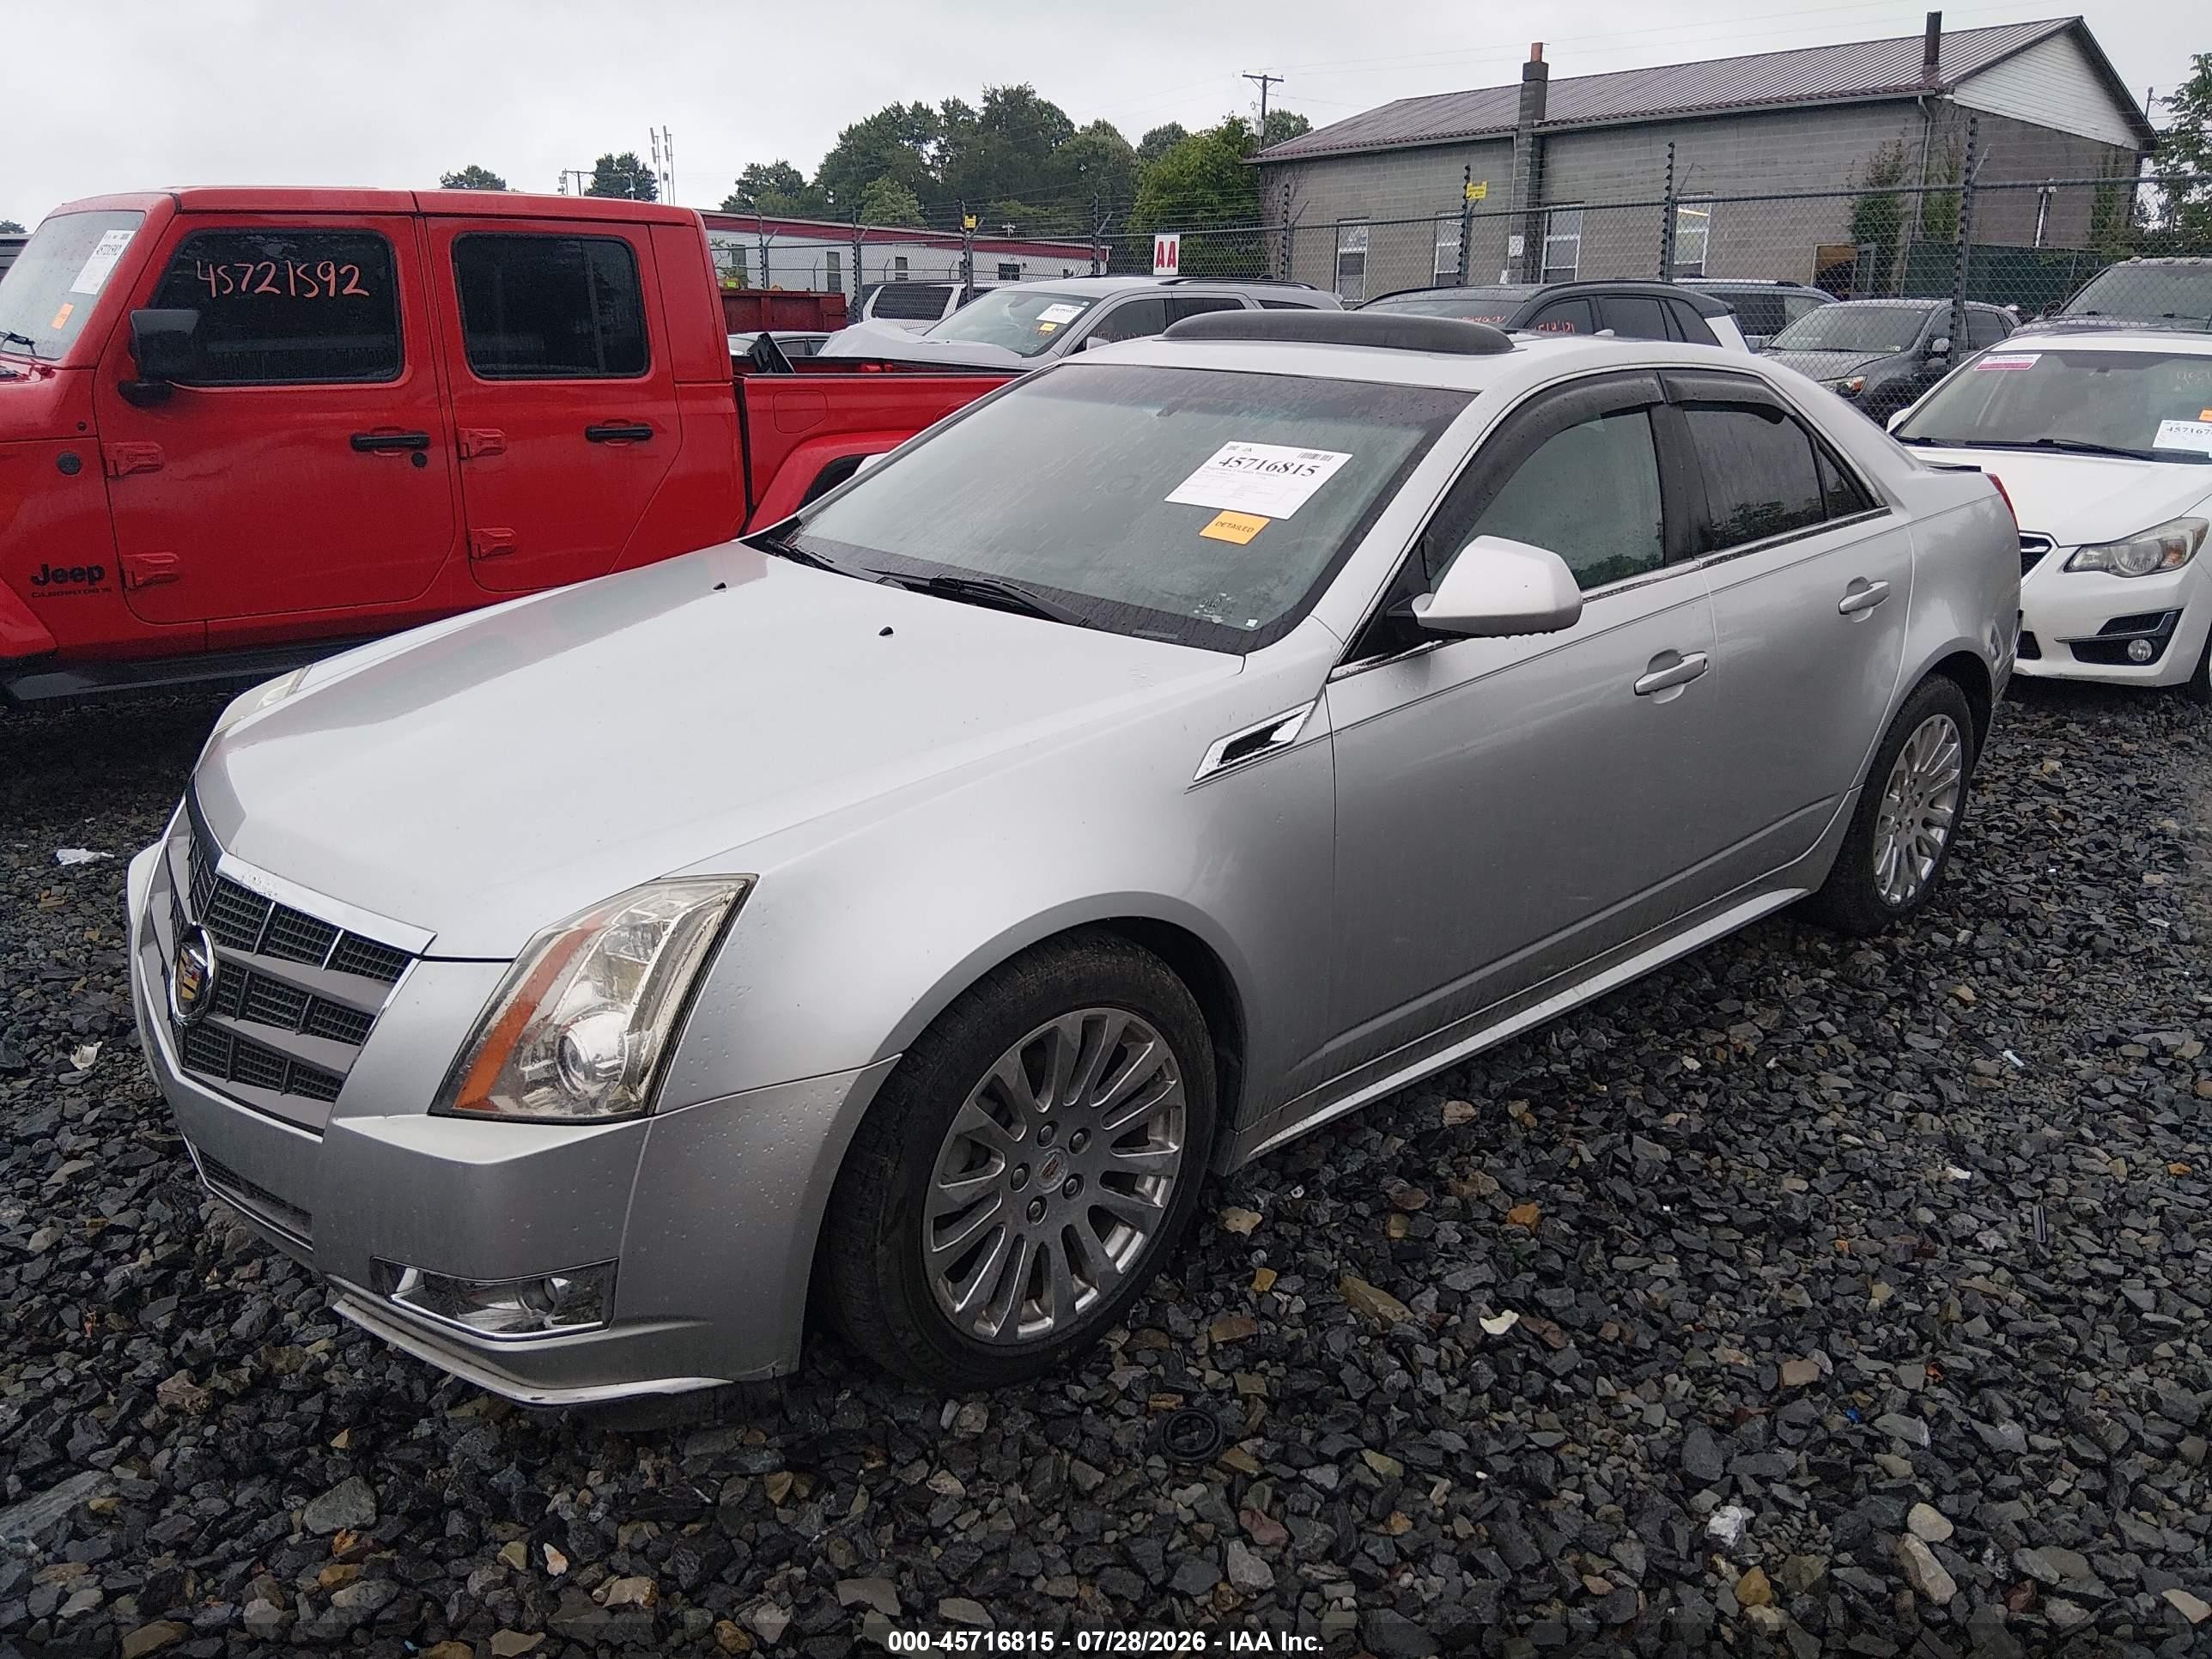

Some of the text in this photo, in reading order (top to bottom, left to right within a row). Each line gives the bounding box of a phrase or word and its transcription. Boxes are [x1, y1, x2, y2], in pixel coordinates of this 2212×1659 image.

[1155, 240, 1176, 268] AA
[197, 259, 369, 298] 45721592
[1218, 455, 1320, 477] 45716815
[1215, 520, 1255, 533] DETAILED
[31, 563, 105, 586] Jeep
